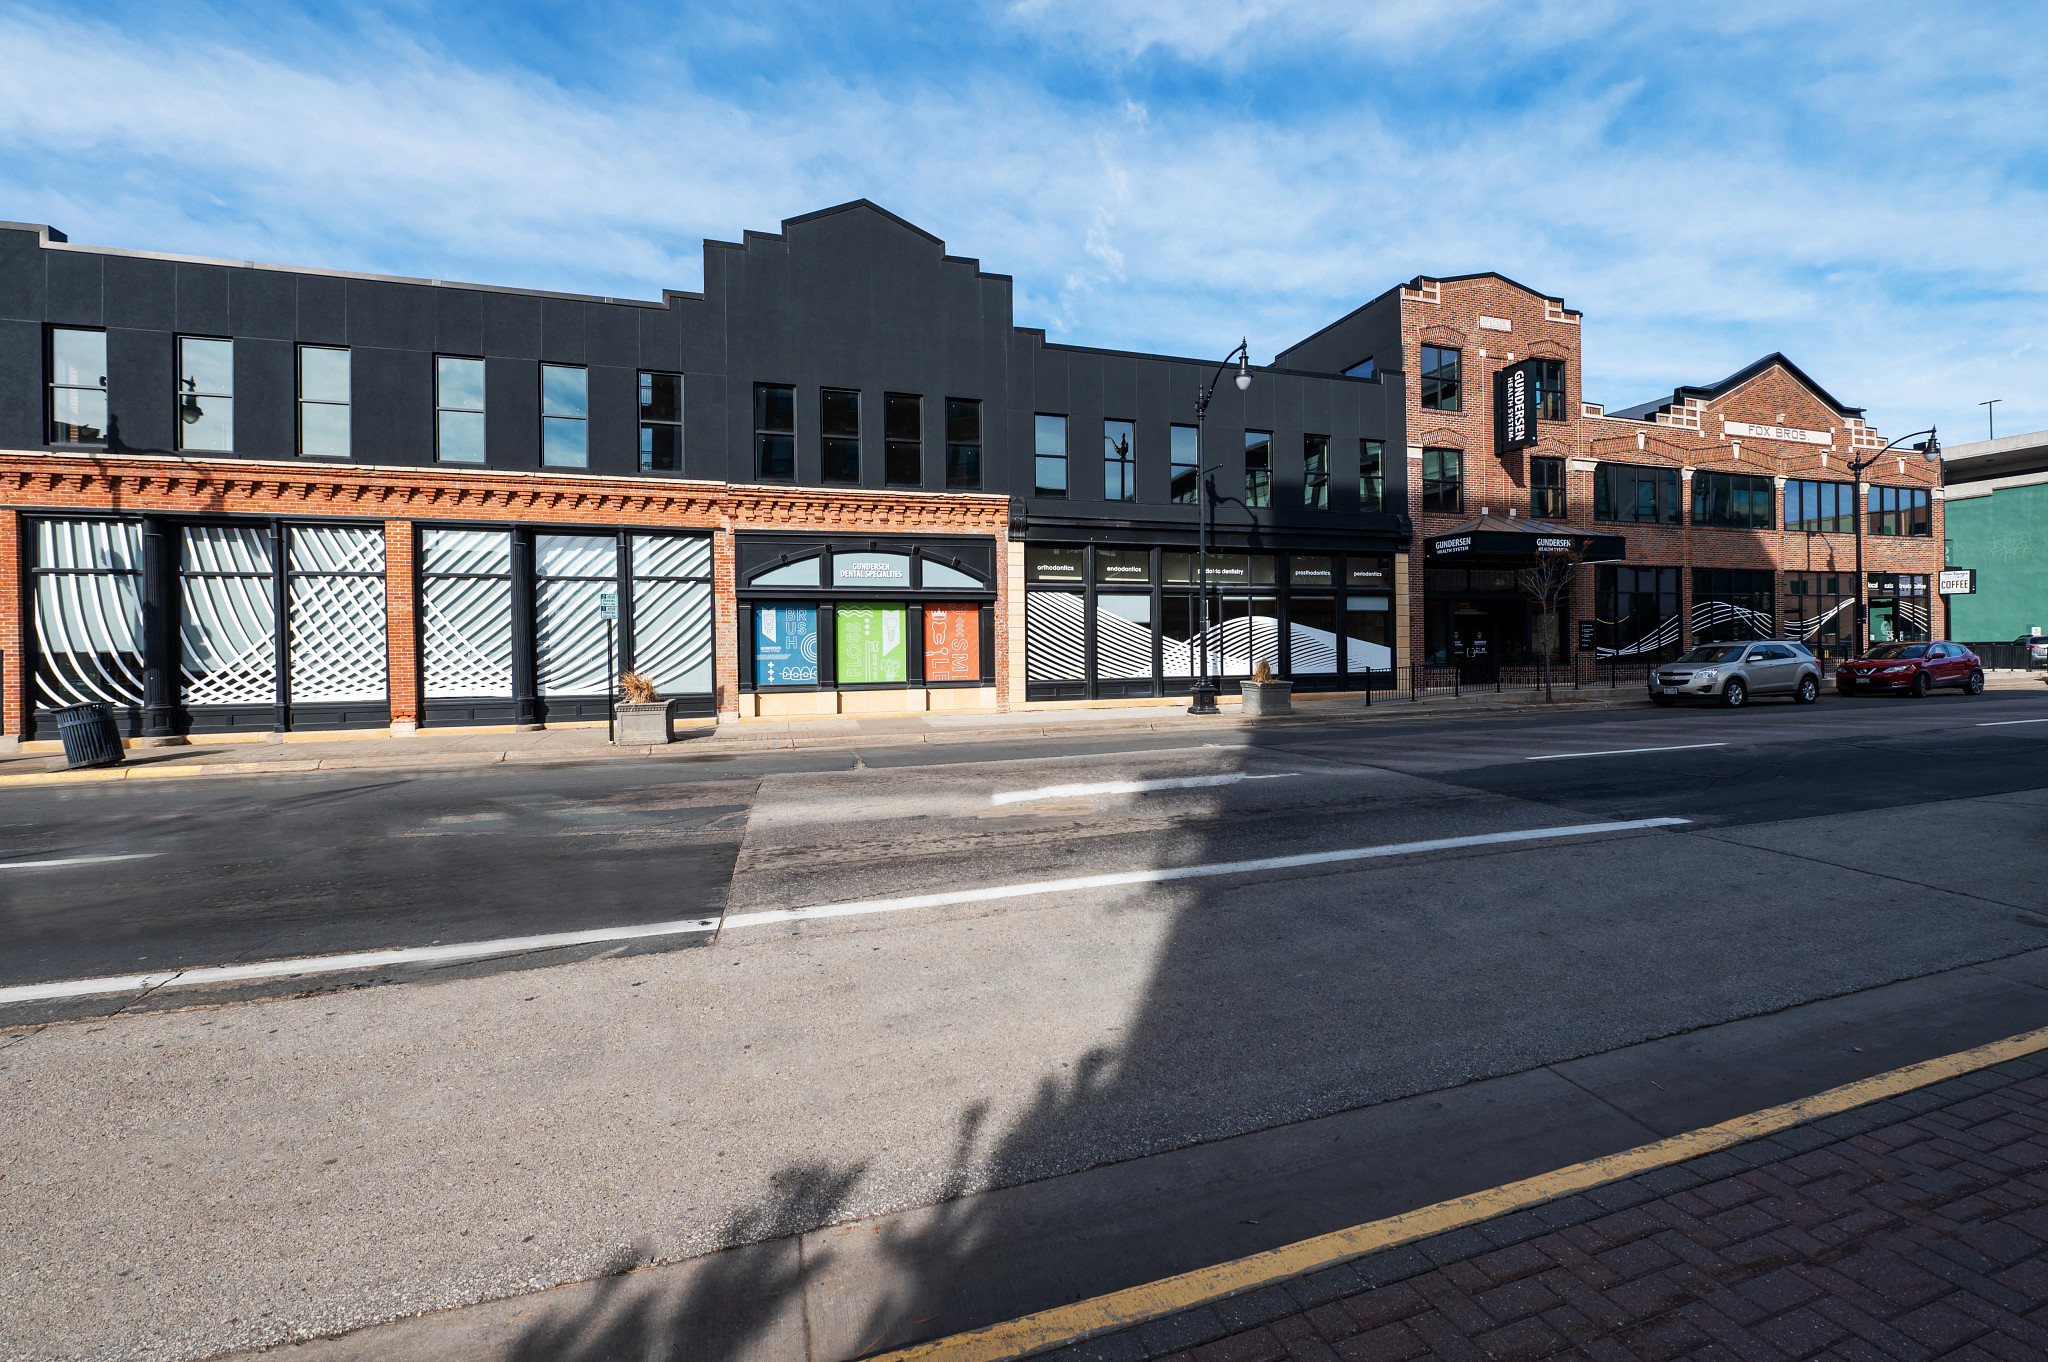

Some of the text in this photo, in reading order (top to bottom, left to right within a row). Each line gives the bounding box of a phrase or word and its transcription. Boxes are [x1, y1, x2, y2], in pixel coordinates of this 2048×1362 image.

[1514, 370, 1525, 441] GUNDERSEN
[1748, 425, 1810, 441] FOX BROS.
[1435, 536, 1472, 549] GUNDERSEN
[1536, 538, 1571, 547] GUNDERSEN
[852, 562, 890, 571] GUNDERSEN
[840, 570, 903, 578] DENTAL SPECIALTIES
[1221, 568, 1244, 576] dentistry
[1868, 581, 1879, 589] local
[1941, 579, 1969, 590] COFFEE
[846, 622, 861, 677] FLOSS
